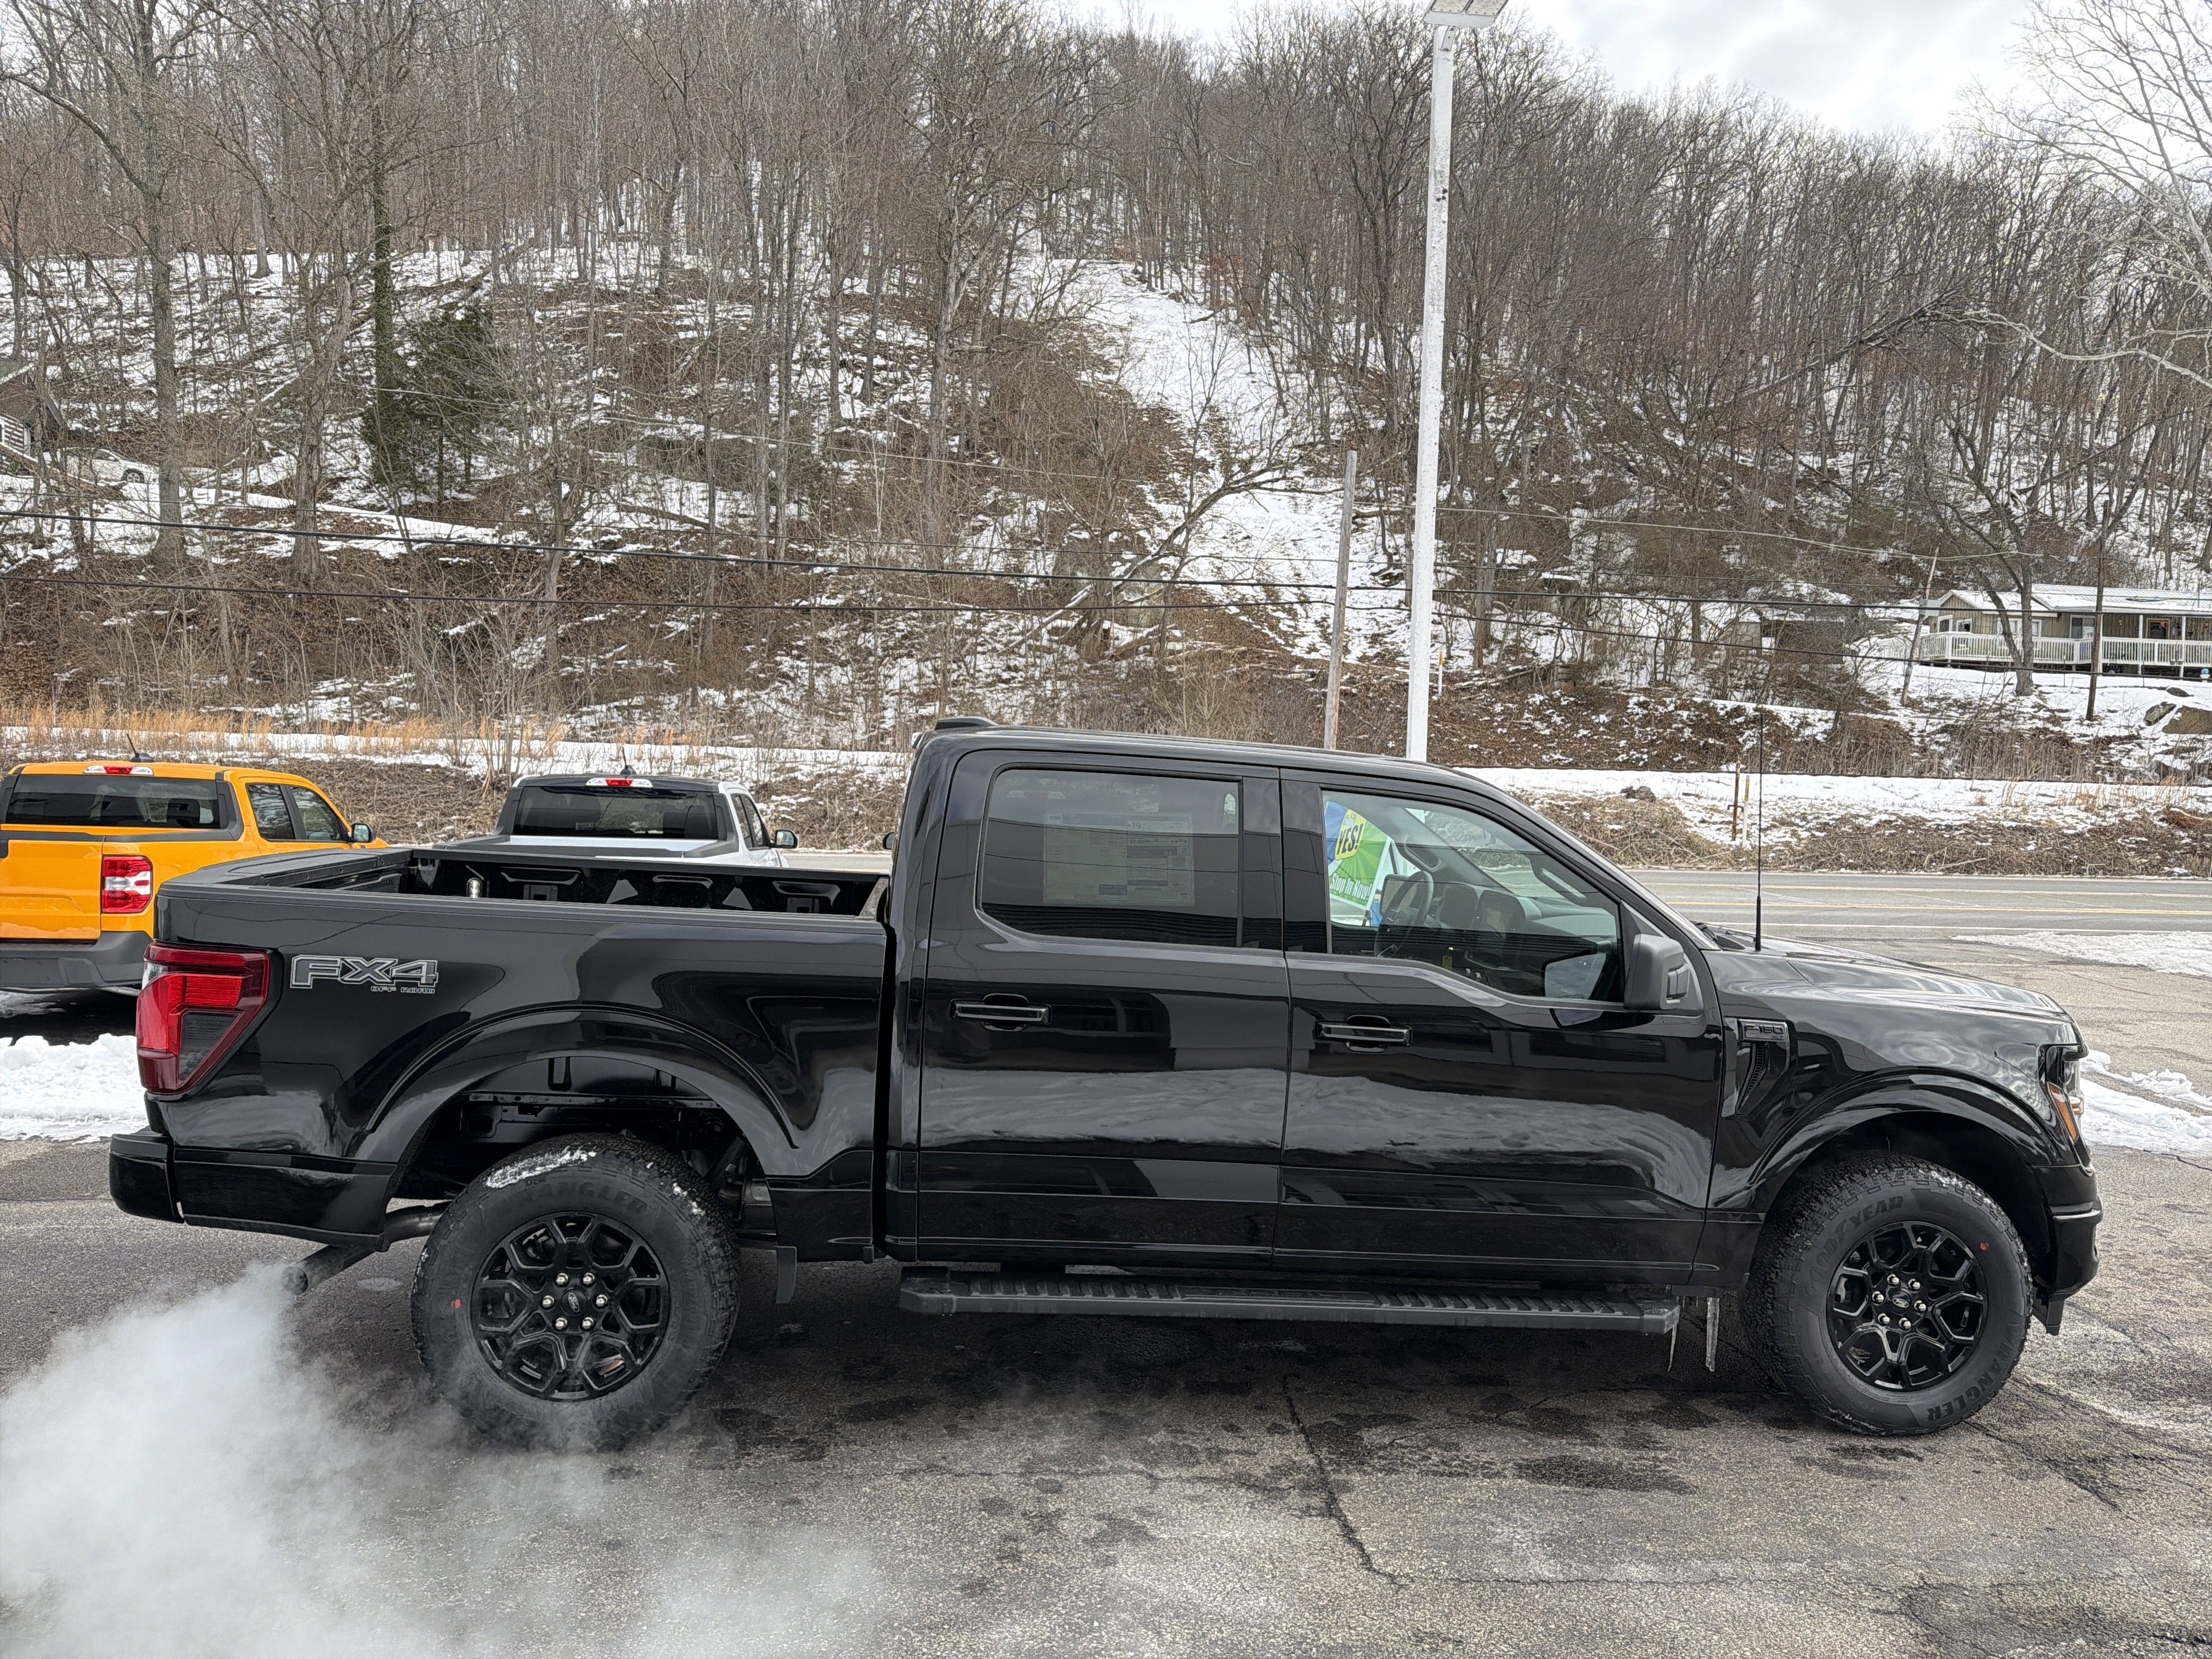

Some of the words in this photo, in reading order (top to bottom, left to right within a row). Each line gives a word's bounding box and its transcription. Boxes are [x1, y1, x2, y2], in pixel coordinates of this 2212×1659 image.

[1336, 823, 1364, 855] YES!
[1330, 873, 1346, 894] Stop
[1352, 879, 1372, 901] Now!
[290, 955, 438, 989] FX4
